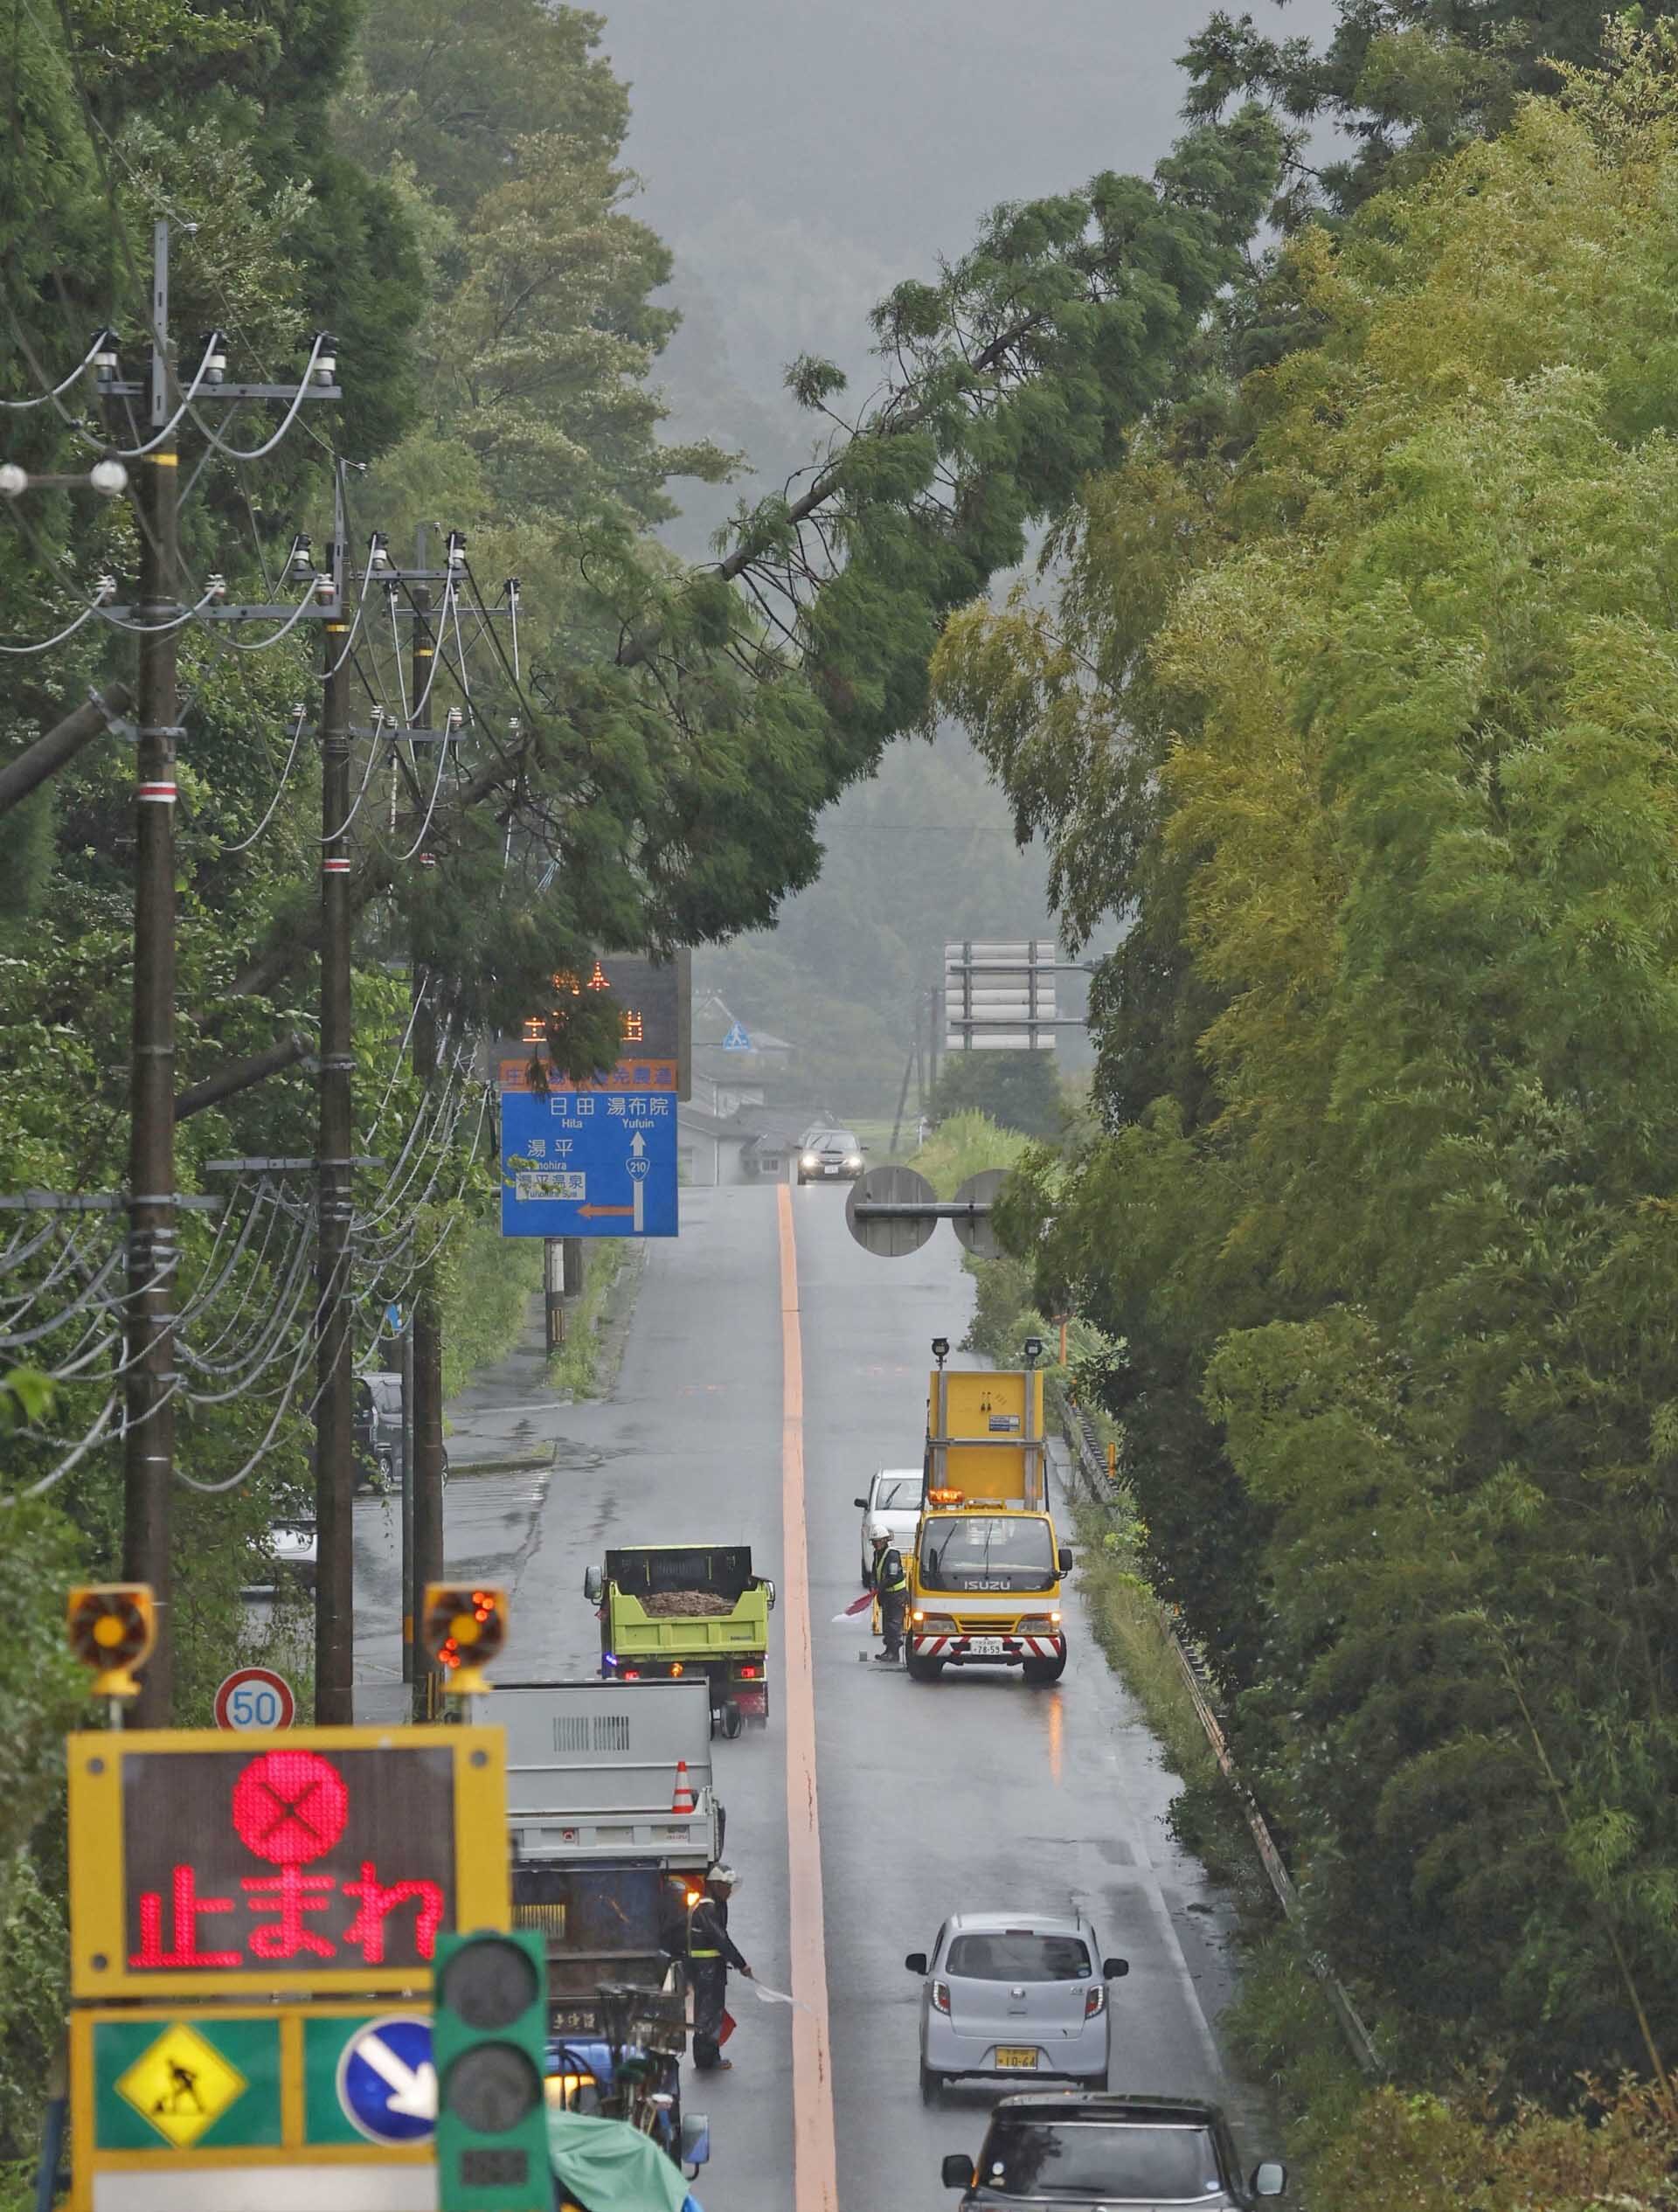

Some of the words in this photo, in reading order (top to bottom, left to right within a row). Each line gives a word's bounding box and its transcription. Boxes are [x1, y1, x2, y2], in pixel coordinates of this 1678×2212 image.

[551, 1097, 594, 1115] 日田
[607, 1097, 669, 1116] 湯布院
[528, 1139, 573, 1157] 湯平
[630, 1161, 647, 1173] 210
[964, 1580, 1010, 1591] ISUZU
[232, 1692, 276, 1726] 50
[128, 1861, 444, 1967] 止まれ
